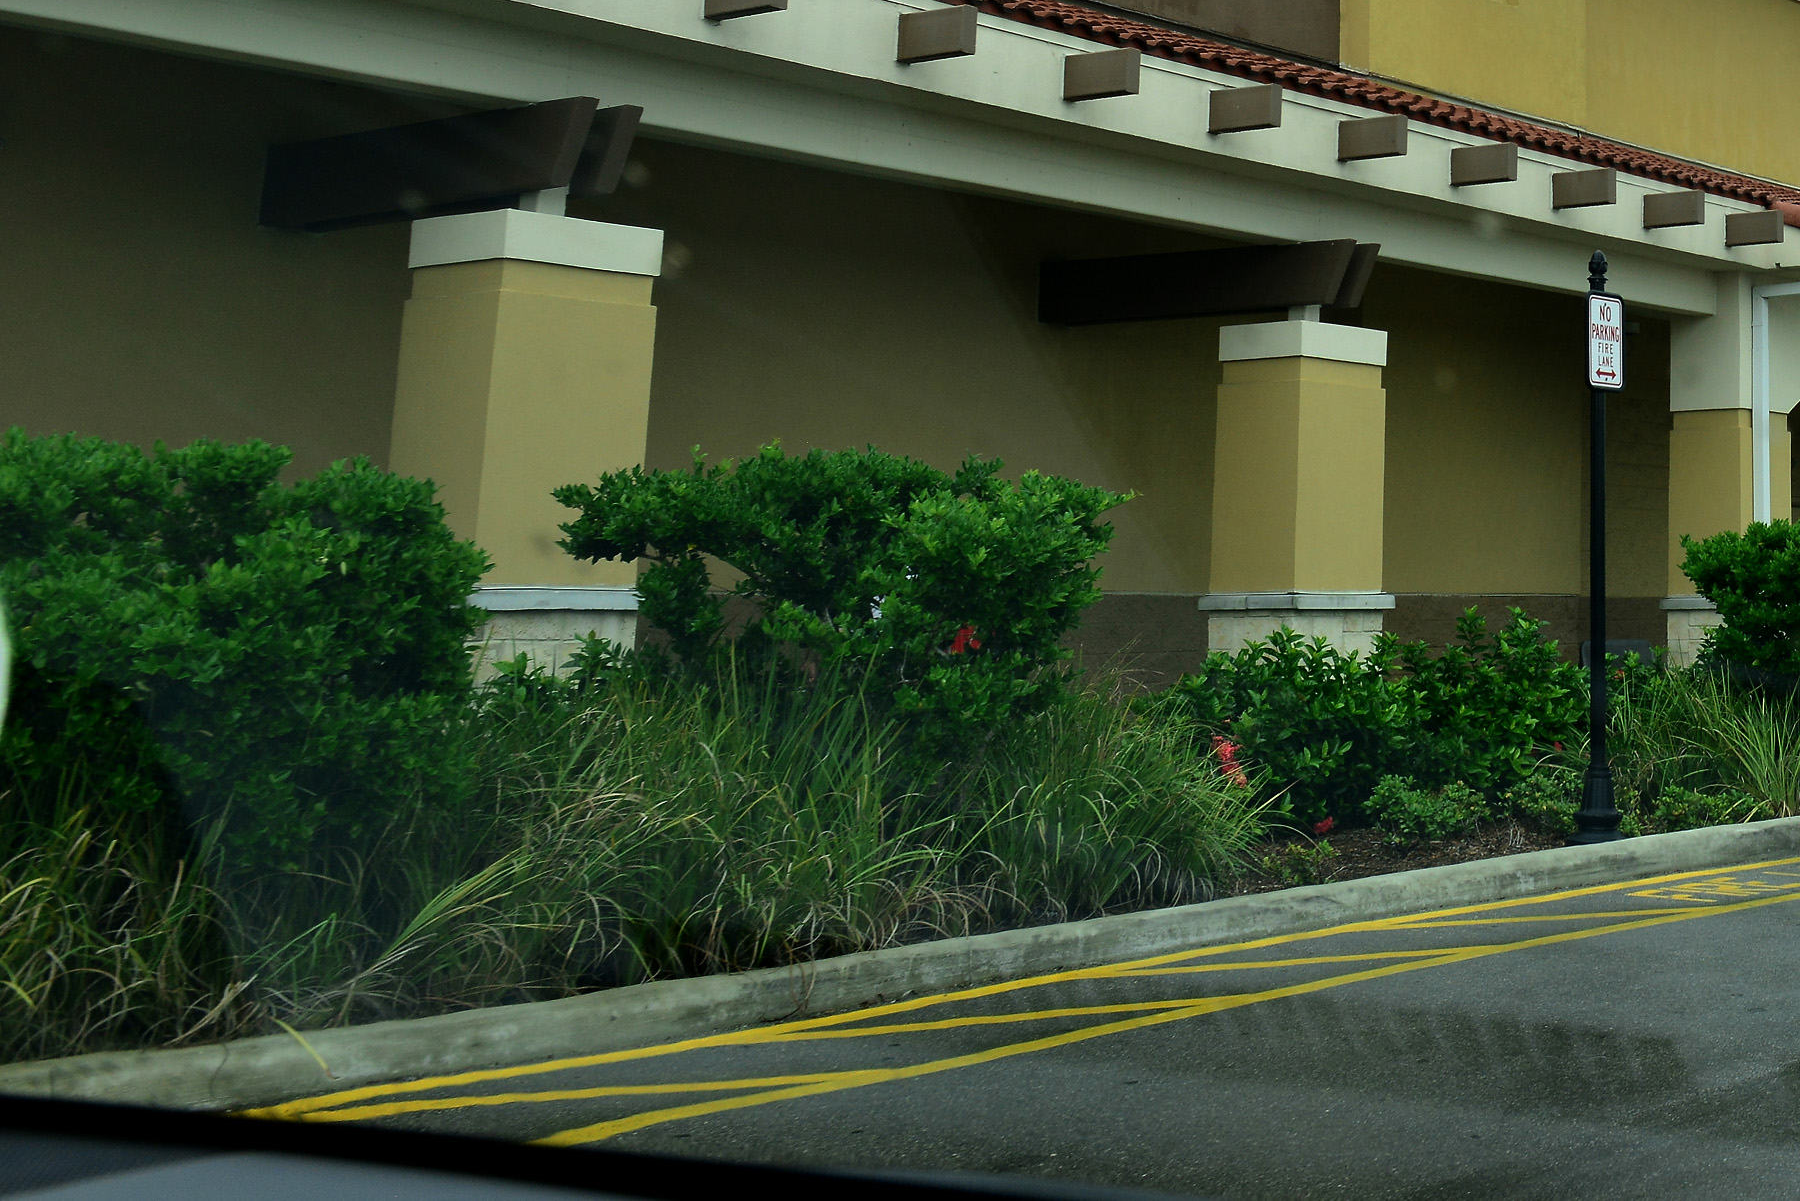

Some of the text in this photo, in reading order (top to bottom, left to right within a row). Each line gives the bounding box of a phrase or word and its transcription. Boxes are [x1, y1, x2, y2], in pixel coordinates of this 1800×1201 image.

[1599, 305, 1612, 322] NO
[1591, 323, 1620, 343] PARKING
[1598, 342, 1614, 355] FIRE
[1598, 355, 1614, 368] LANE
